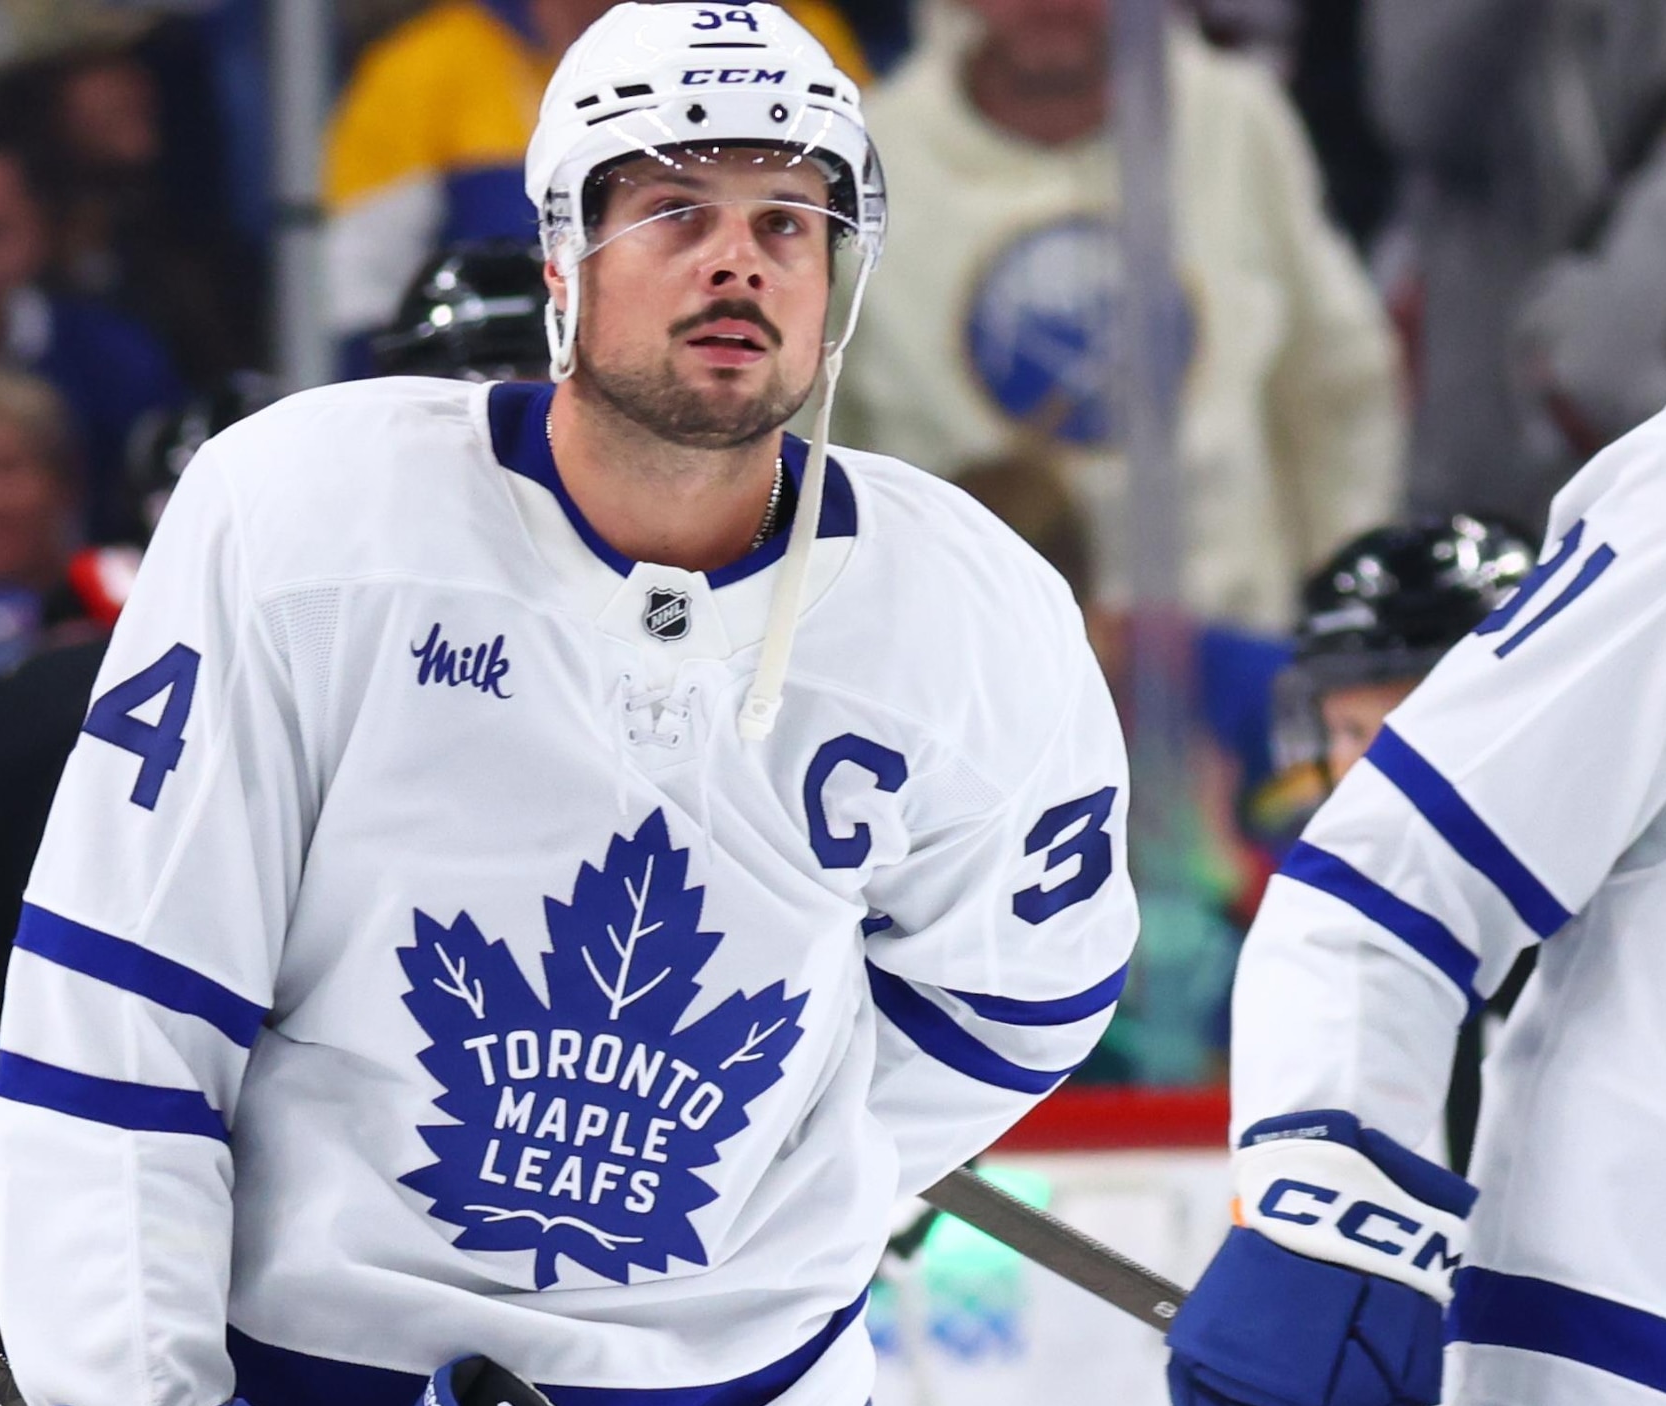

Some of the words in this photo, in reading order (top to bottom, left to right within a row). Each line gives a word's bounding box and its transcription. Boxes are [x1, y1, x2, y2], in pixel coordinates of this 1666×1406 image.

[691, 9, 758, 32] 34
[679, 68, 788, 85] CCM
[651, 601, 684, 630] NHL
[411, 622, 515, 699] Milk
[82, 642, 201, 811] 4
[803, 733, 908, 870] C
[1012, 786, 1118, 926] 3
[463, 1029, 724, 1131] TORONTO
[494, 1086, 677, 1163] MAPLE
[479, 1139, 660, 1214] LEAFS
